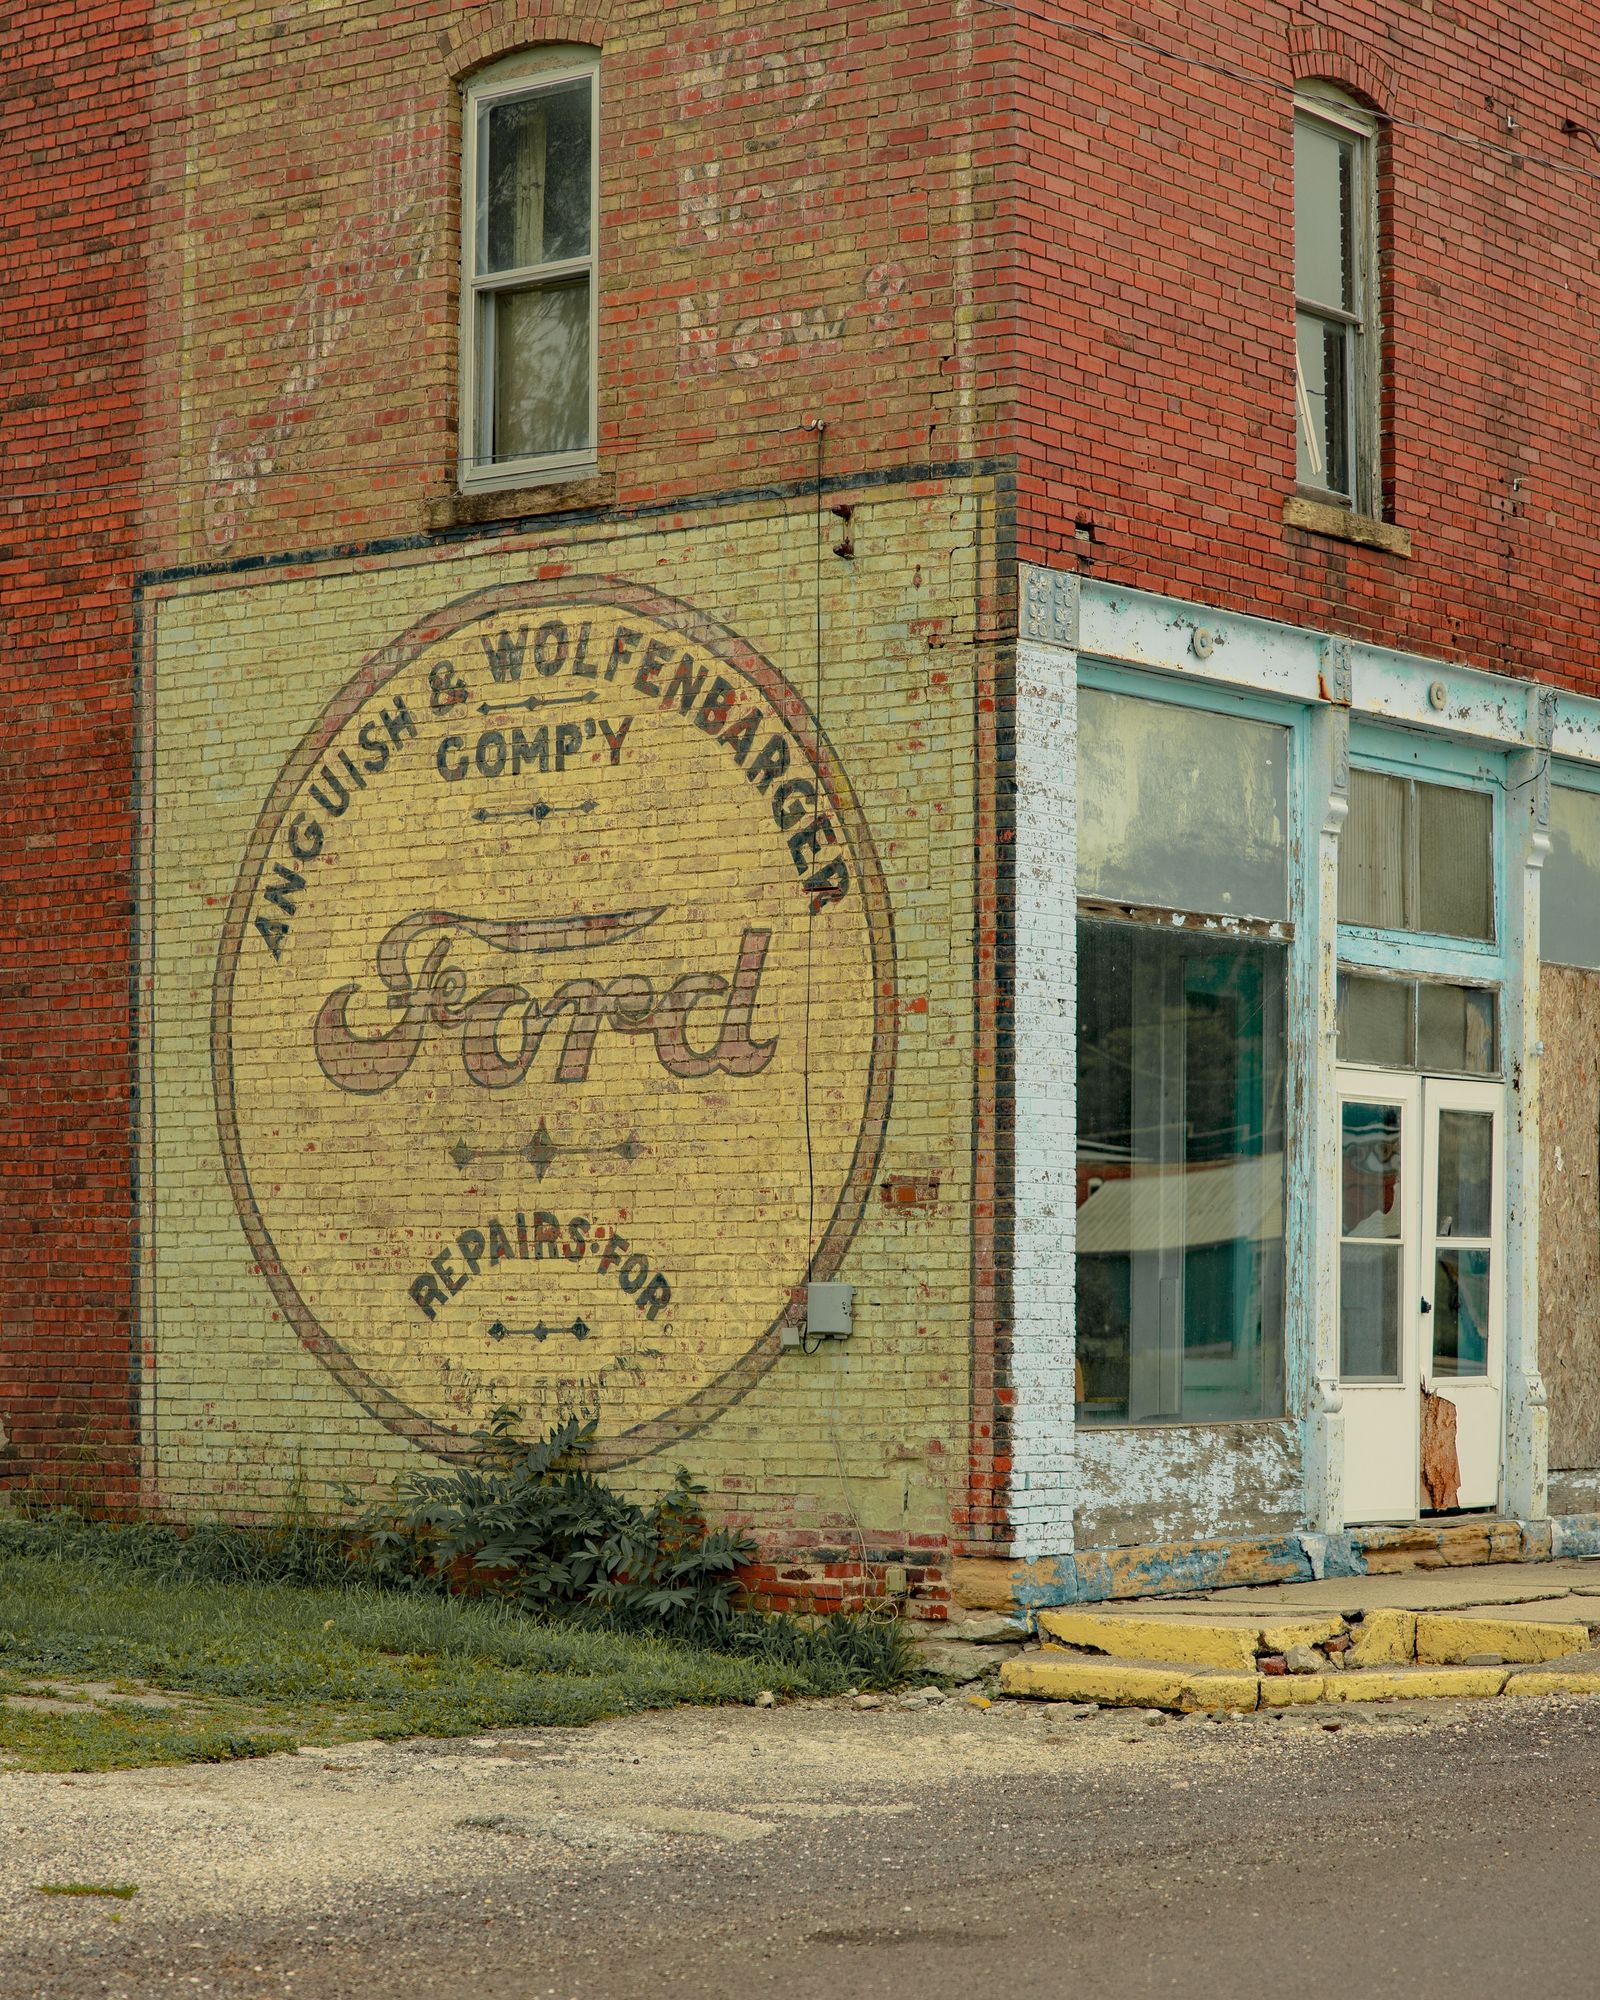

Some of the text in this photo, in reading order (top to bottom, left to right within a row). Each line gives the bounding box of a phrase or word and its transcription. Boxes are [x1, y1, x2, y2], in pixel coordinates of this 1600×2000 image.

[251, 618, 851, 960] ANGUISH & WOLFENBARGER
[313, 904, 780, 1097] Ford
[408, 1210, 672, 1322] REPAIRS FOR
